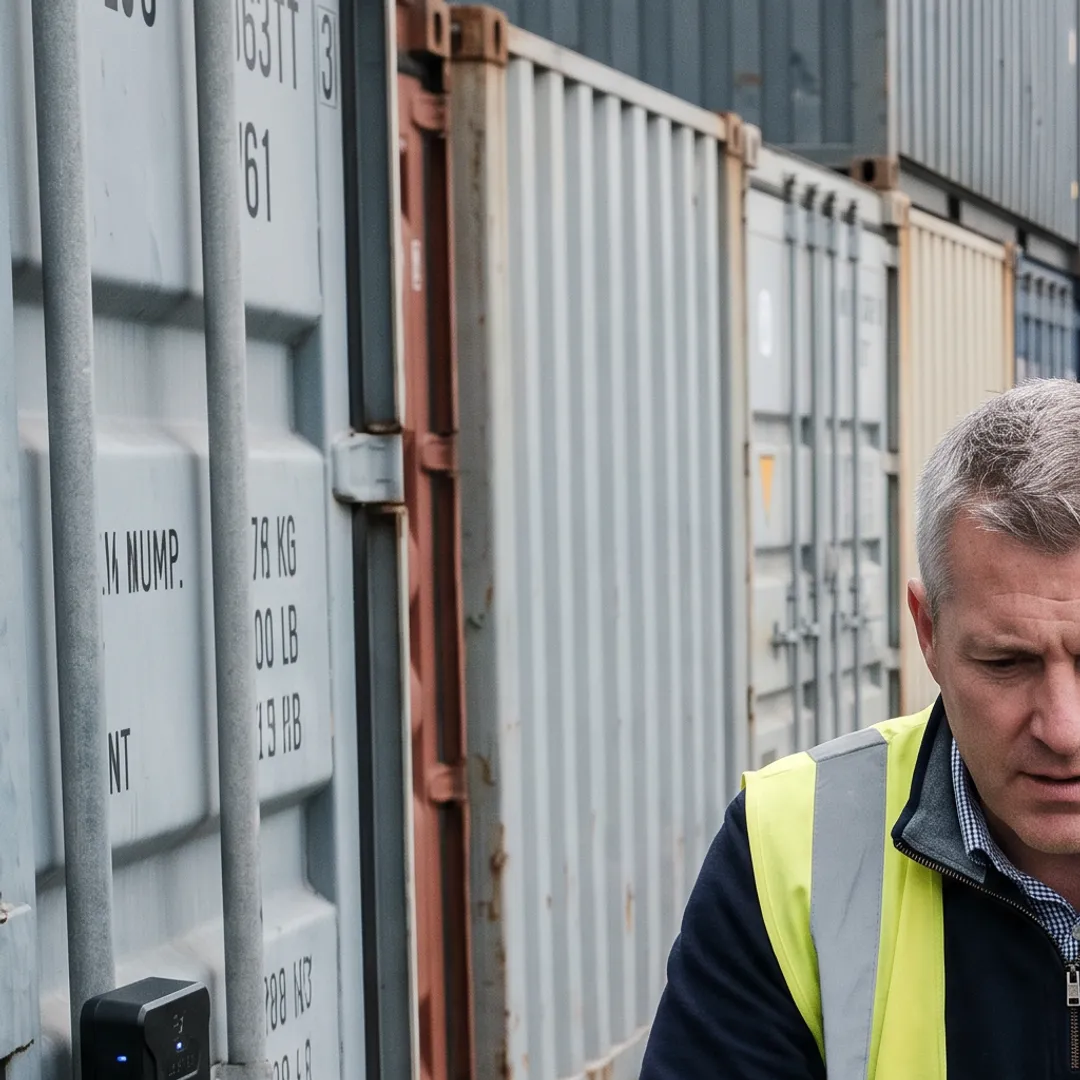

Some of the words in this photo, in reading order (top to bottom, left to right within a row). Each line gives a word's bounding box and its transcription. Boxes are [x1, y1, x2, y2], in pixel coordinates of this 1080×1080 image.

[239, 121, 271, 222] 61
[276, 515, 297, 578] KG
[281, 604, 298, 665] LB
[108, 728, 131, 794] NT
